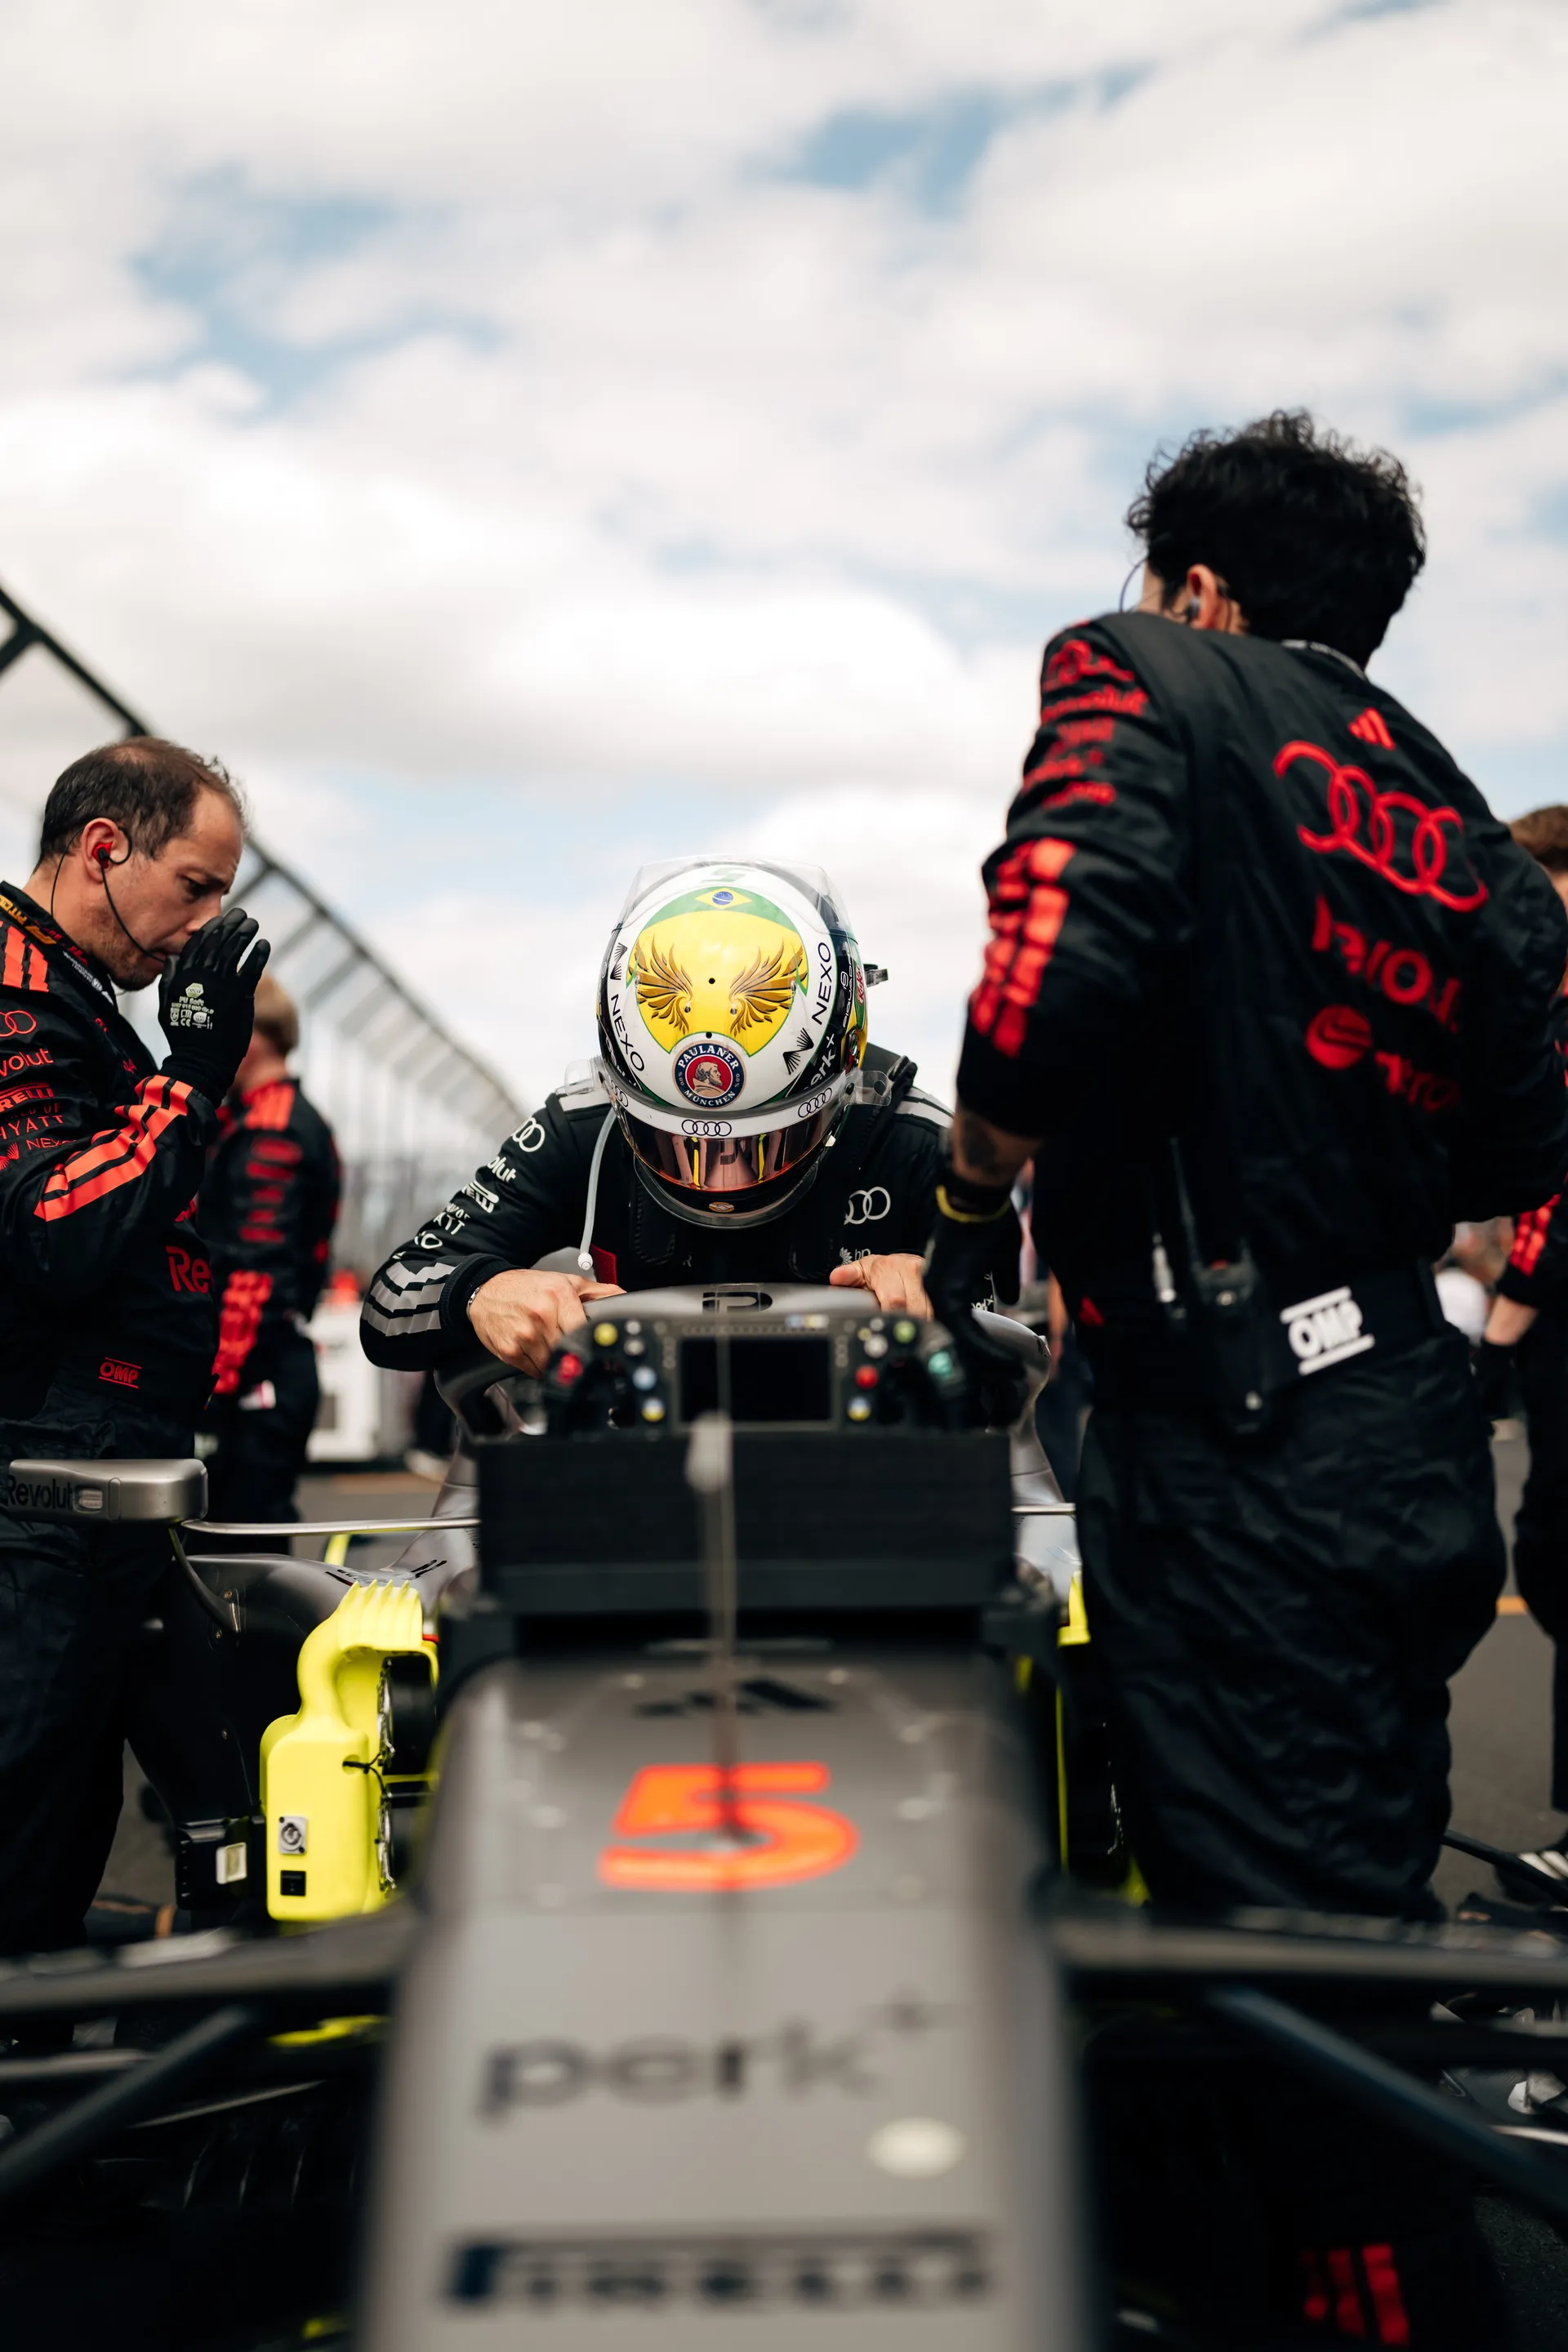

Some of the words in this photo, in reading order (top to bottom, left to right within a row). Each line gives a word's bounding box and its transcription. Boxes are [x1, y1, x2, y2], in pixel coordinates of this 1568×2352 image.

[811, 942, 833, 1026] NEXO
[611, 993, 645, 1072] NEXO
[677, 1045, 740, 1070] PAULANER
[26, 1138, 78, 1151] NEX
[1284, 1294, 1369, 1365] OMP
[99, 1359, 140, 1386] OMP
[6, 1477, 75, 1511] Revolut
[598, 1762, 860, 1891] 5
